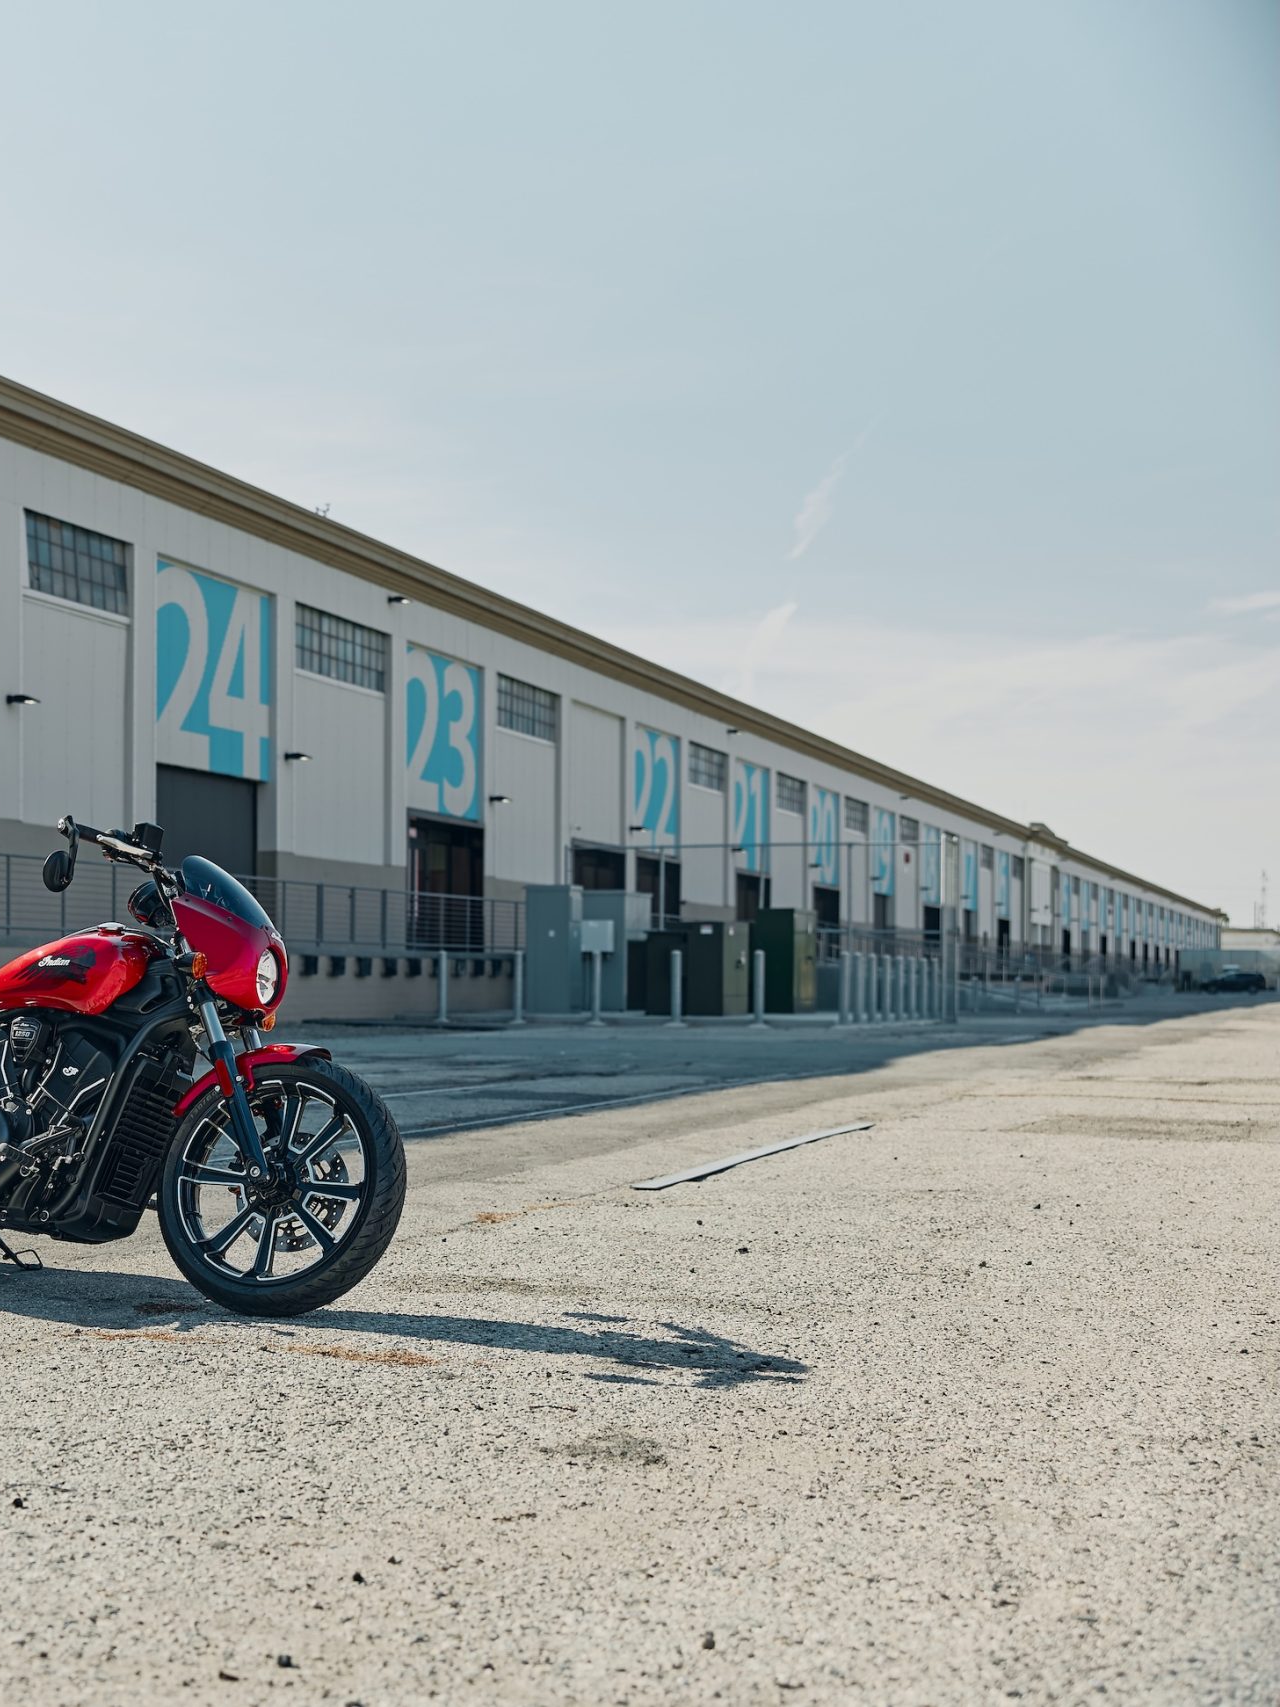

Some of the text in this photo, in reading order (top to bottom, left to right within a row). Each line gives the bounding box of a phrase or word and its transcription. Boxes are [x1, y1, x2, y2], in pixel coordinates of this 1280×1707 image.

[156, 565, 269, 780] 24
[407, 650, 476, 817] 23
[634, 729, 676, 858] 22
[735, 762, 763, 872] 21
[38, 955, 70, 967] Indian
[15, 1030, 31, 1038] 1250
